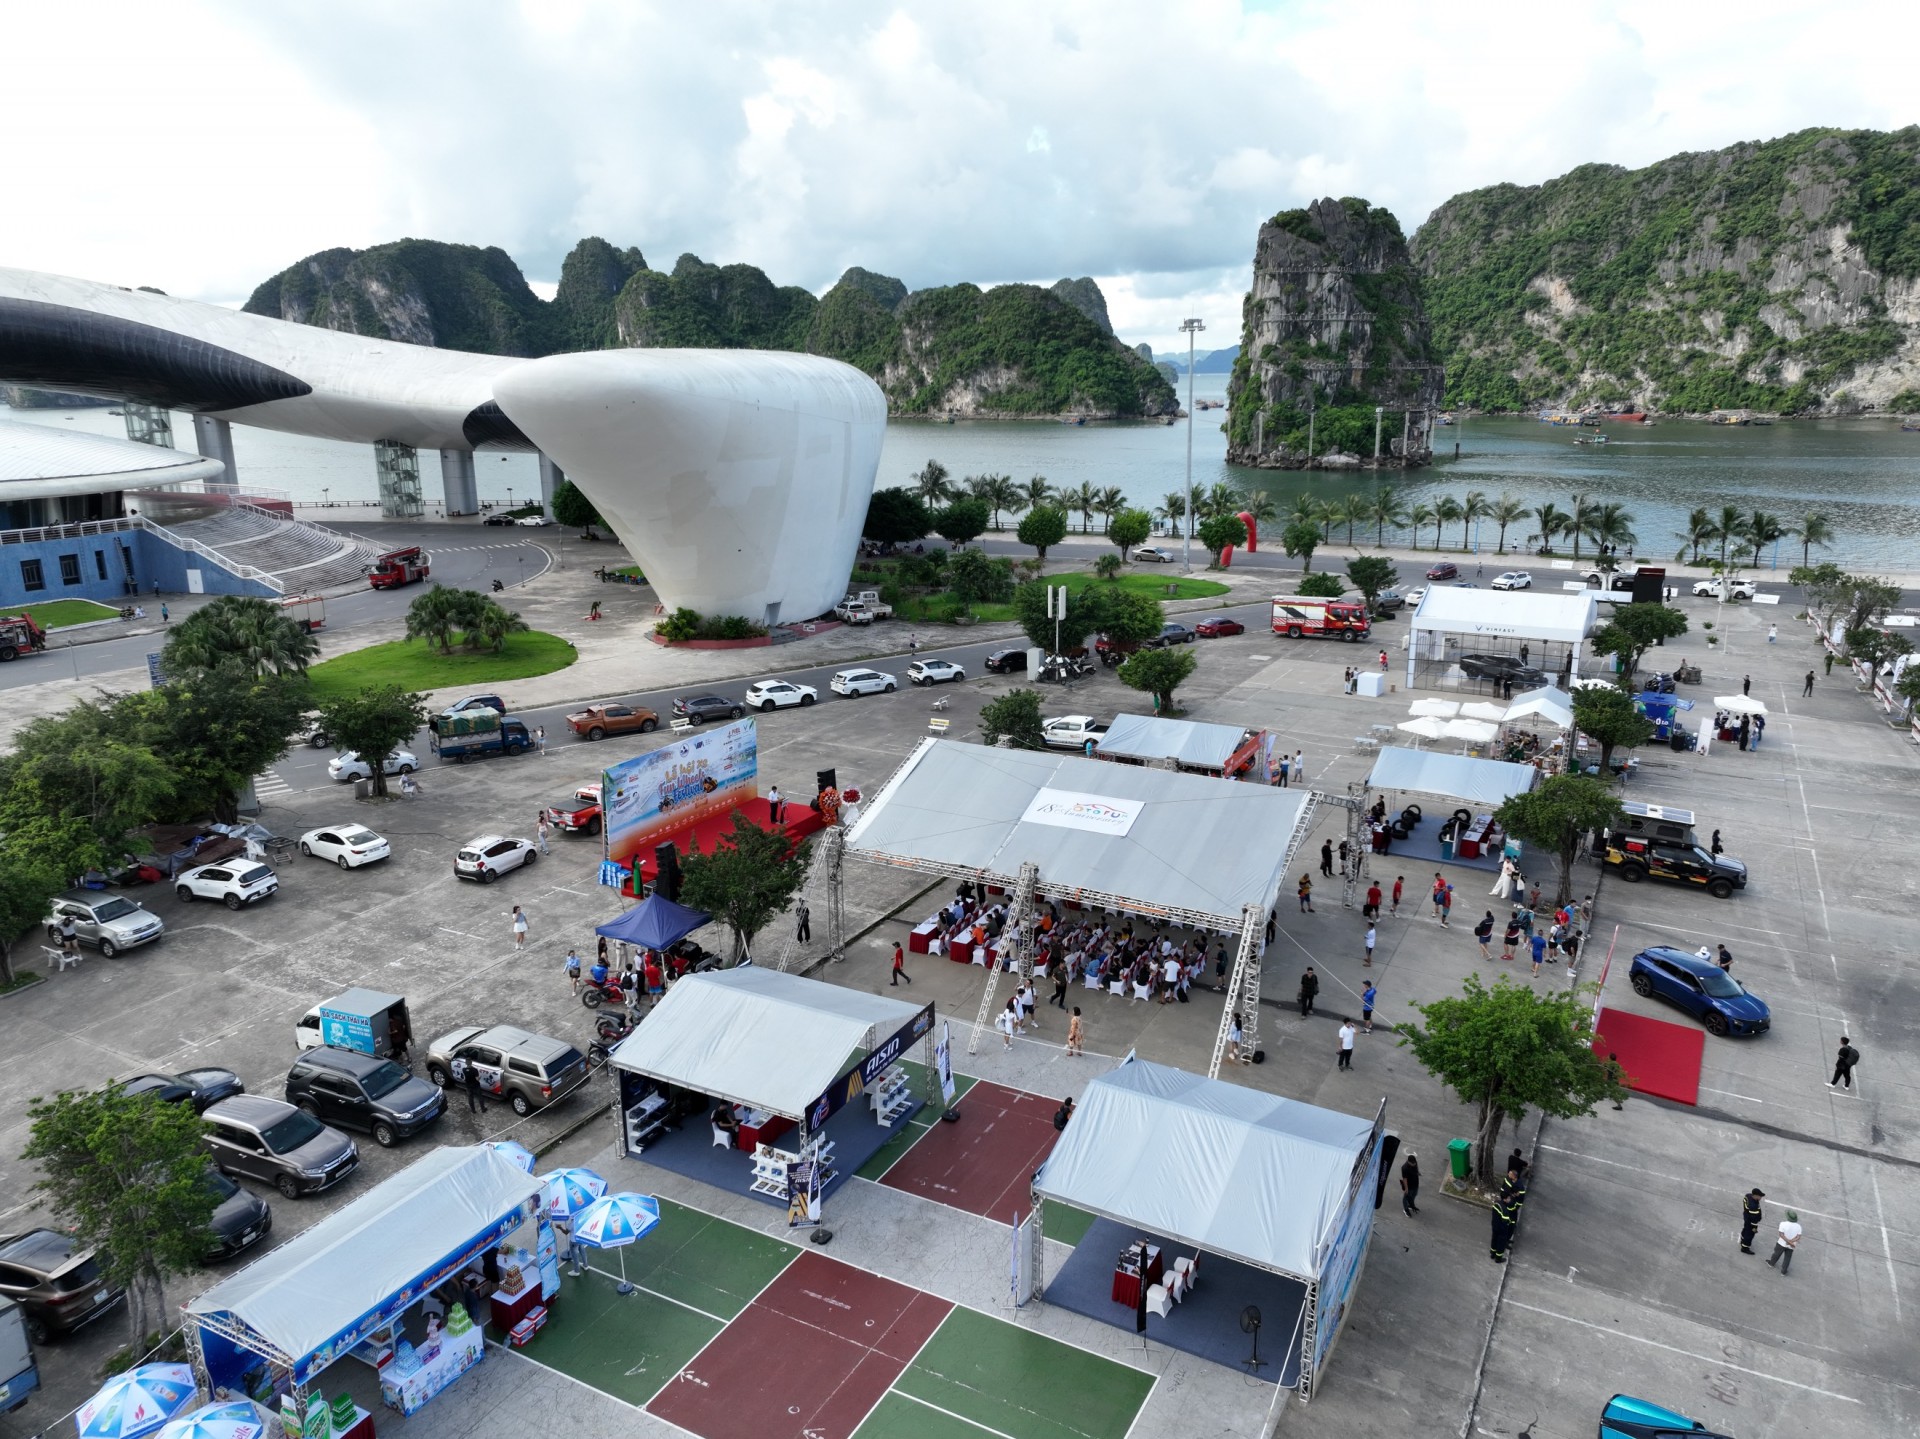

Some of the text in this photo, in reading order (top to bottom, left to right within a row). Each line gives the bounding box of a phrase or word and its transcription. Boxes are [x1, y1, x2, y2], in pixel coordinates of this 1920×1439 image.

[677, 768, 705, 788] Wheels
[672, 780, 704, 804] Festival
[866, 1037, 900, 1075] AISIN
